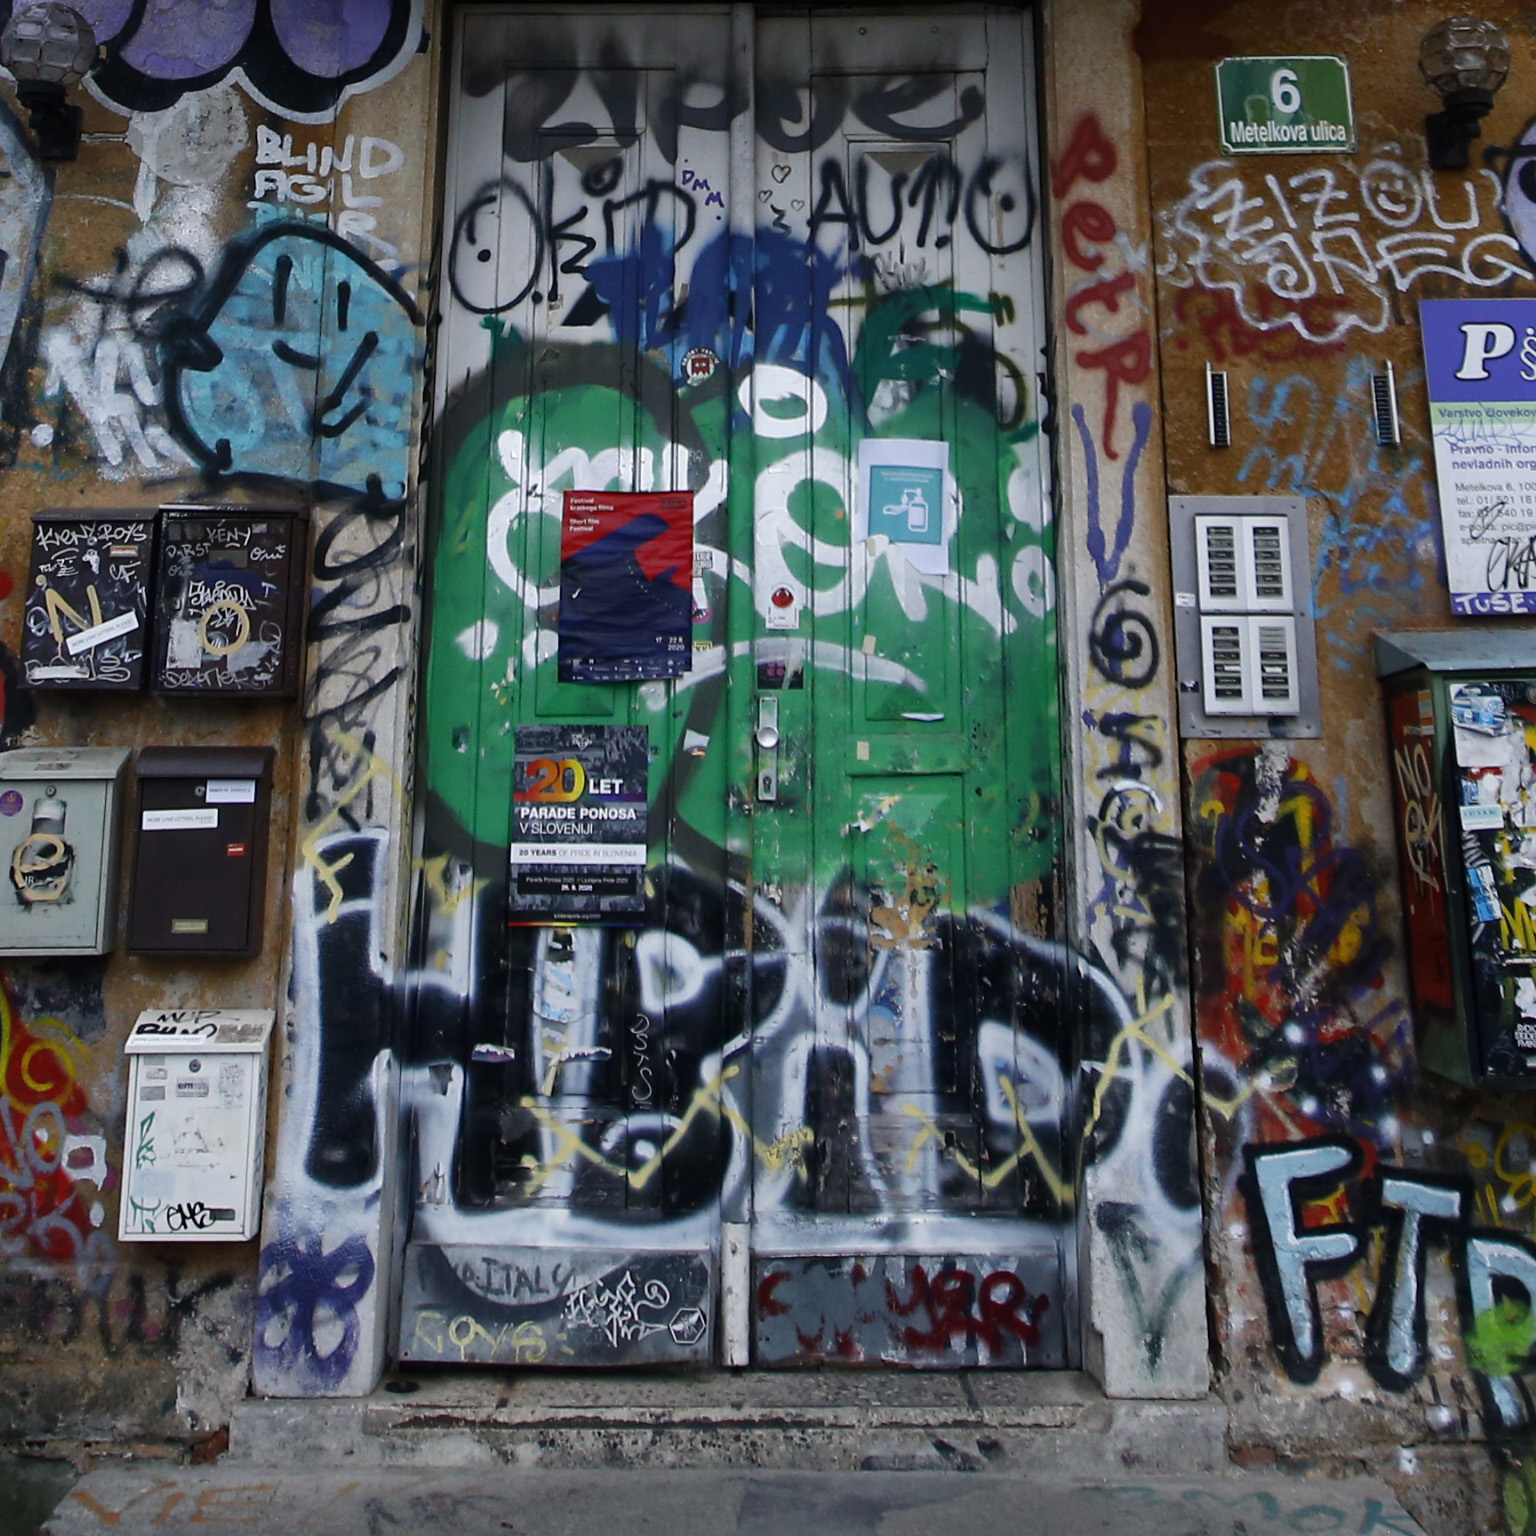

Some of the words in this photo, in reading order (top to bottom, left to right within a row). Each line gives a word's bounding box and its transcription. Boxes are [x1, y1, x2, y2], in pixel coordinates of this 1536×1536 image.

[1272, 68, 1302, 114] 6
[1230, 120, 1308, 143] Metelkova
[1311, 120, 1347, 142] ulica
[1438, 407, 1482, 419] Varstvo
[1450, 444, 1495, 455] Pravno
[1452, 459, 1513, 470] nevladnih
[1455, 483, 1503, 492] Metelkova
[525, 758, 586, 802] 20
[589, 779, 623, 794] LET
[520, 807, 575, 820] PARADE
[580, 808, 637, 820] PONOSA
[519, 823, 529, 834] V
[531, 823, 593, 835] SLOVENIJI
[530, 849, 557, 857] YEARS
